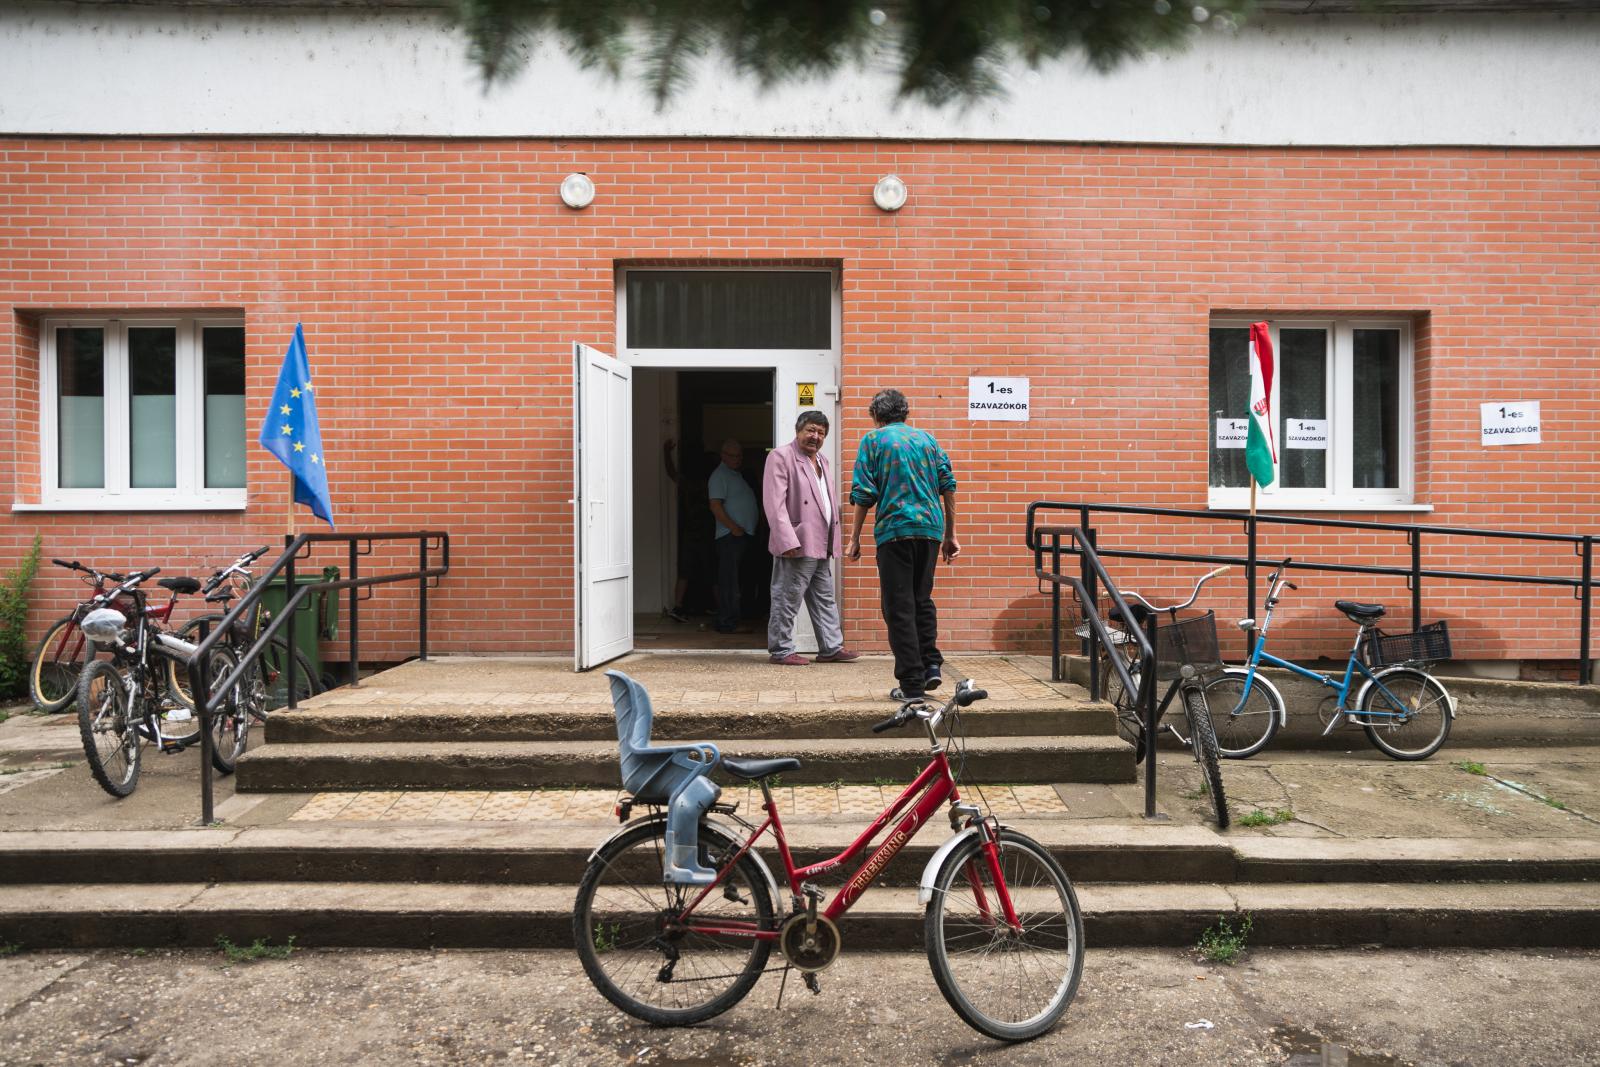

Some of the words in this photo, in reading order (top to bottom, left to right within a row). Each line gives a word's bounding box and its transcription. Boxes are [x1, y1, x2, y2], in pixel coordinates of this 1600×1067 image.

[987, 381, 1013, 394] 1-es
[970, 402, 1028, 410] SZAVAZÓKÖR
[1498, 407, 1524, 419] 1-es
[1229, 421, 1248, 430] 1-es
[1298, 422, 1316, 431] 1-es
[1483, 426, 1539, 435] SZAVAZÓKÖR
[852, 830, 908, 890] TREKKING
